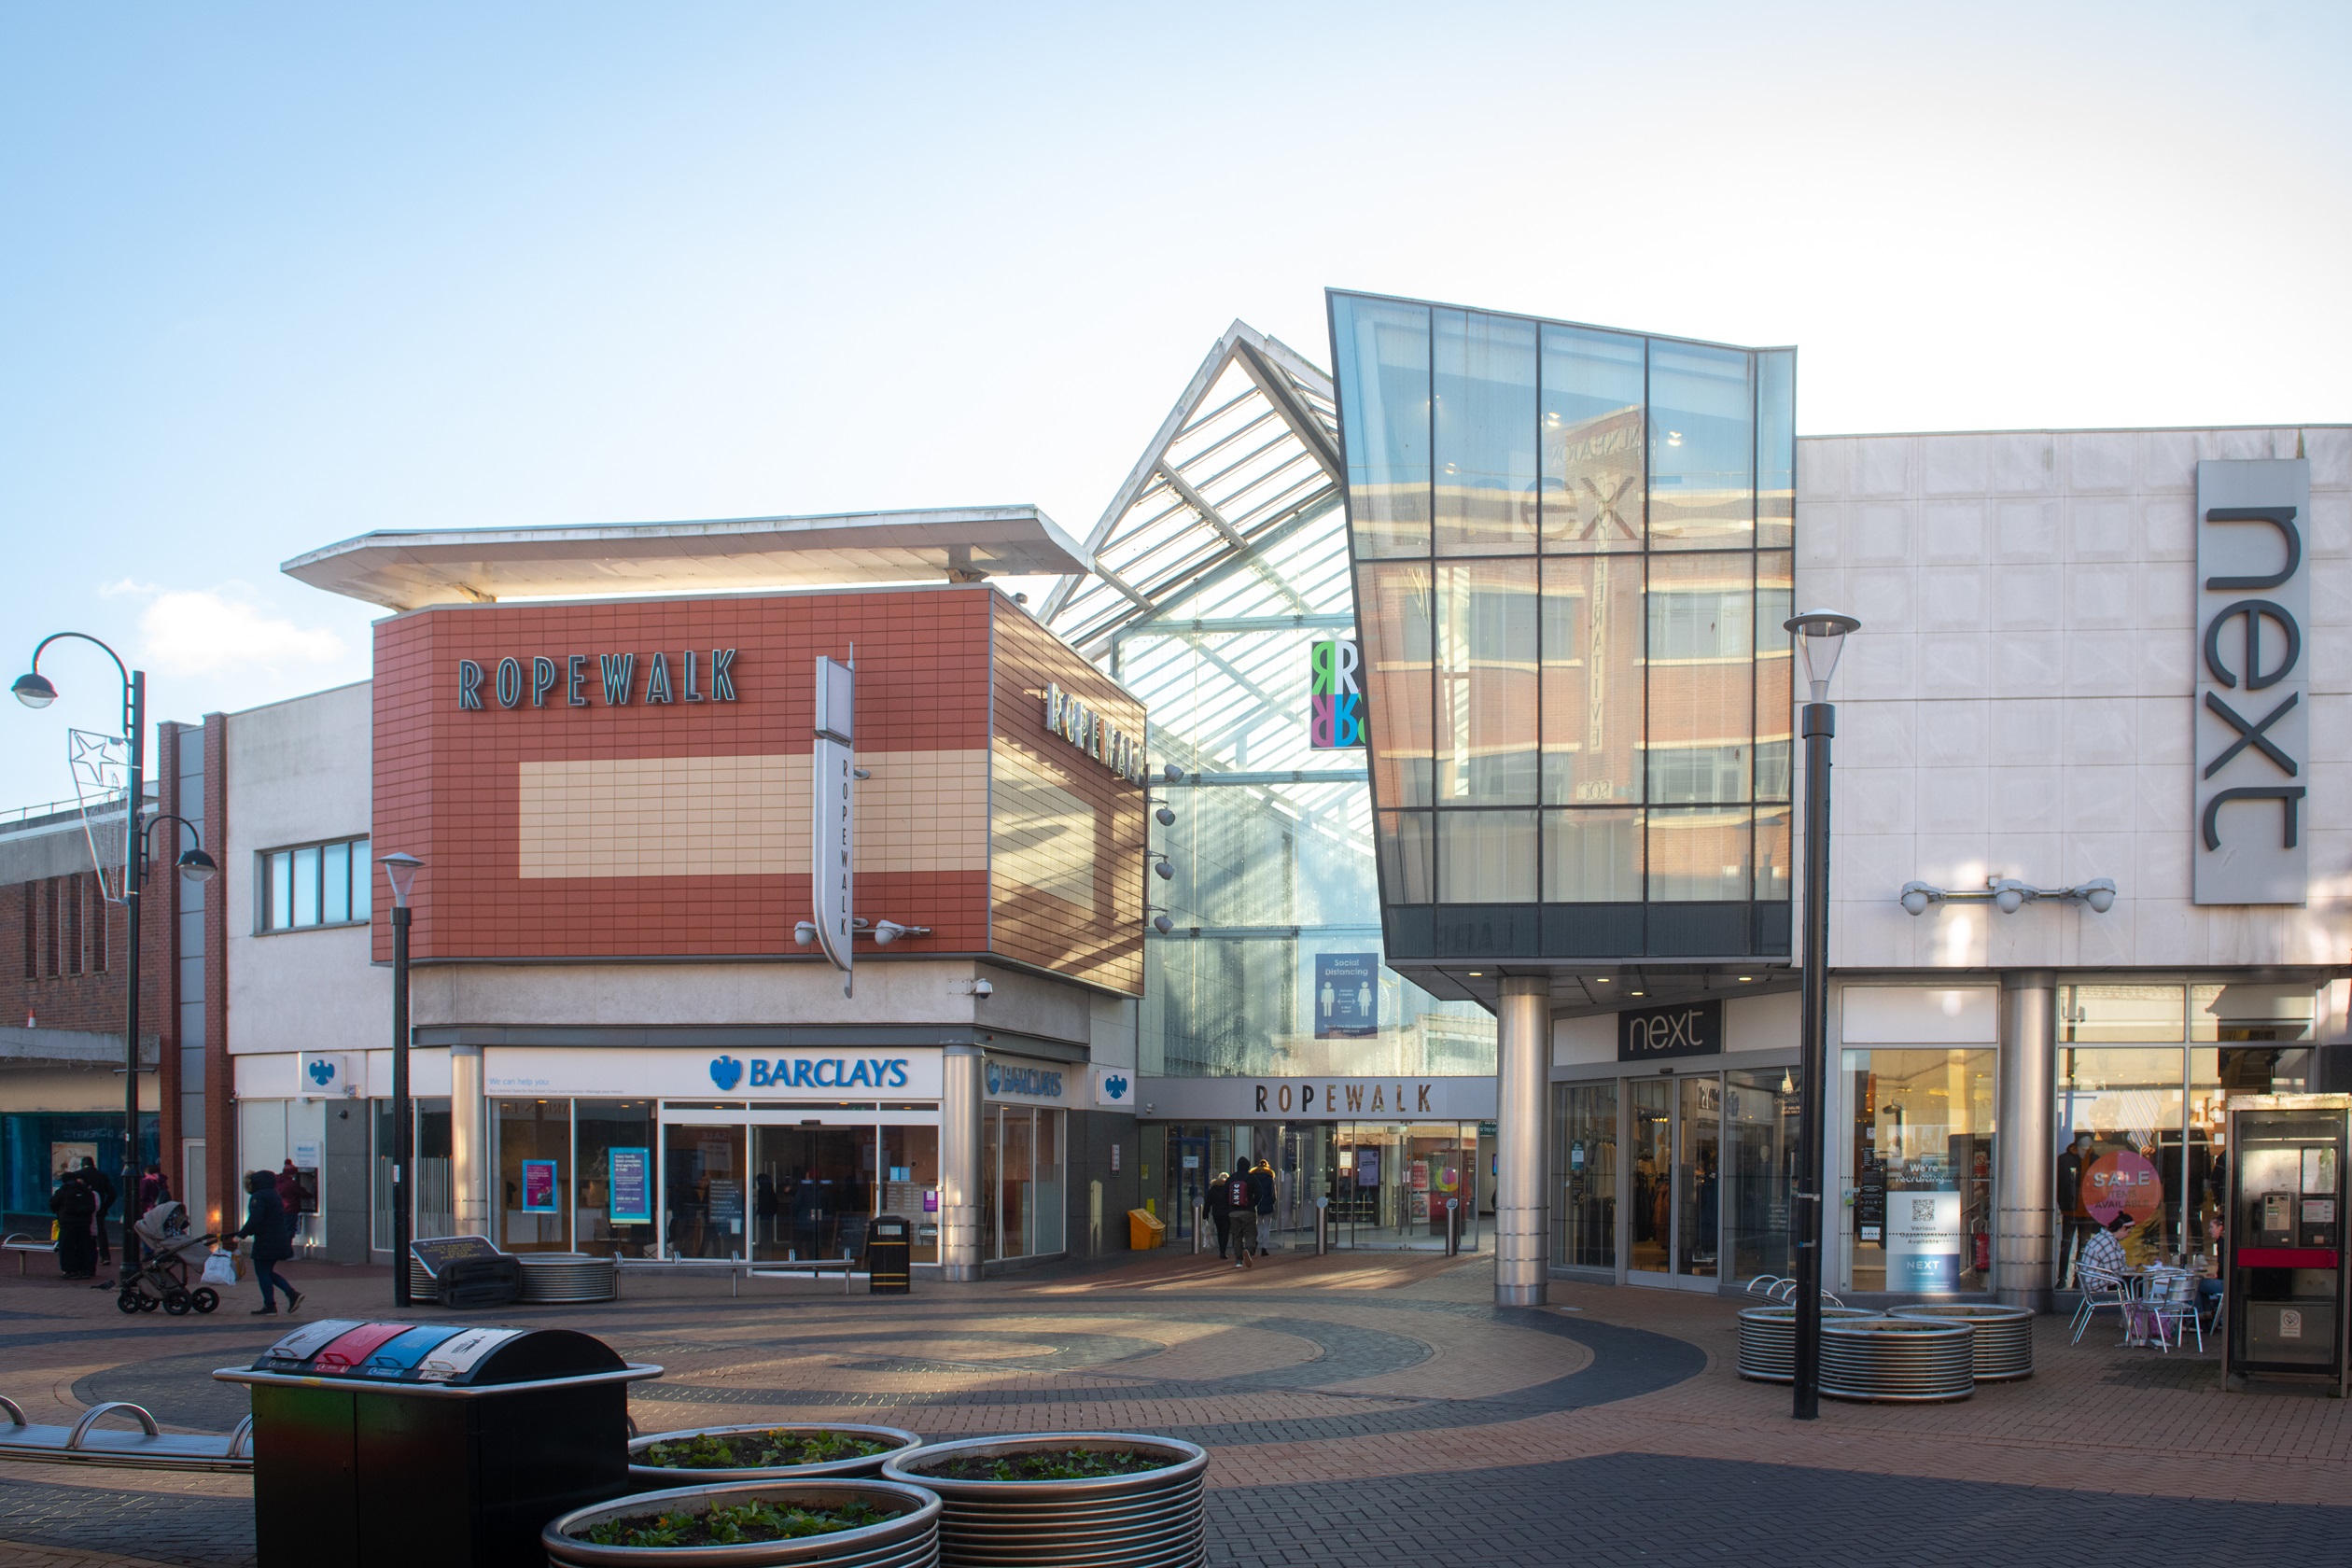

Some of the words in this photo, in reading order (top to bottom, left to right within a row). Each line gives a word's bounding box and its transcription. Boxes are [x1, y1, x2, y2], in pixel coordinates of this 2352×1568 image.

[458, 649, 736, 710] ROPEWALK
[2203, 506, 2307, 851] next
[839, 758, 849, 936] ROPEWALK
[1334, 959, 1360, 967] Social
[1325, 968, 1368, 977] Distancing
[1630, 1009, 1703, 1051] next
[749, 1058, 909, 1088] BARCLAYS
[489, 1077, 501, 1085] We
[517, 1076, 533, 1087] help
[1001, 1065, 1062, 1097] BARCLAYS
[1255, 1084, 1432, 1113] ROPEWALK
[1909, 1163, 1939, 1172] We're
[1896, 1174, 1953, 1184] recruiting...
[2093, 1170, 2150, 1187] SALE
[2107, 1190, 2136, 1198] ITEMS
[2094, 1199, 2149, 1209] AVAILABLE
[1906, 1260, 1940, 1270] NEXT
